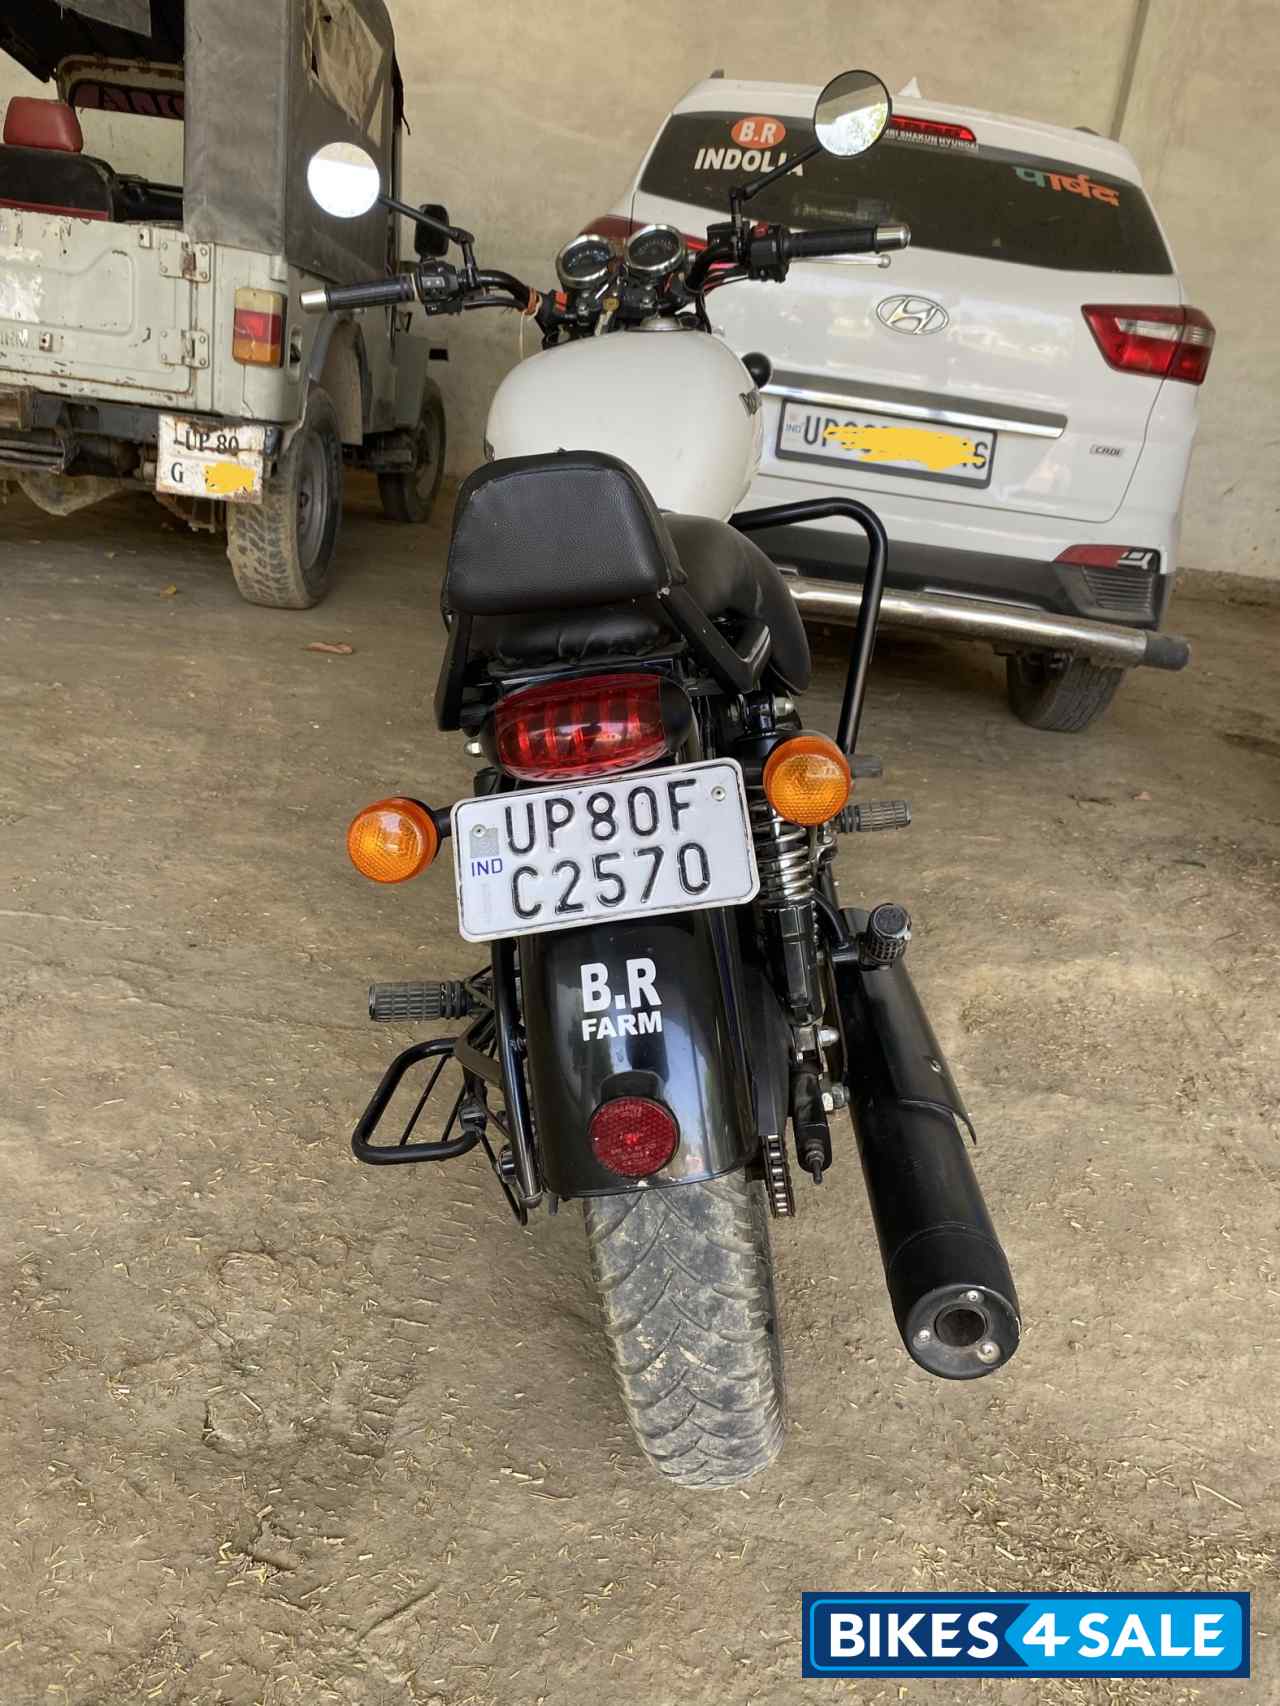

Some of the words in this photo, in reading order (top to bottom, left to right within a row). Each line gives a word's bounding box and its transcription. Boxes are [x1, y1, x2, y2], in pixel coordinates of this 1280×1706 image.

[739, 121, 777, 144] B.R
[505, 778, 697, 854] UP80F
[471, 857, 504, 877] IND
[511, 842, 711, 919] C2570
[580, 957, 663, 1013] B.R
[582, 1010, 663, 1041] FARM
